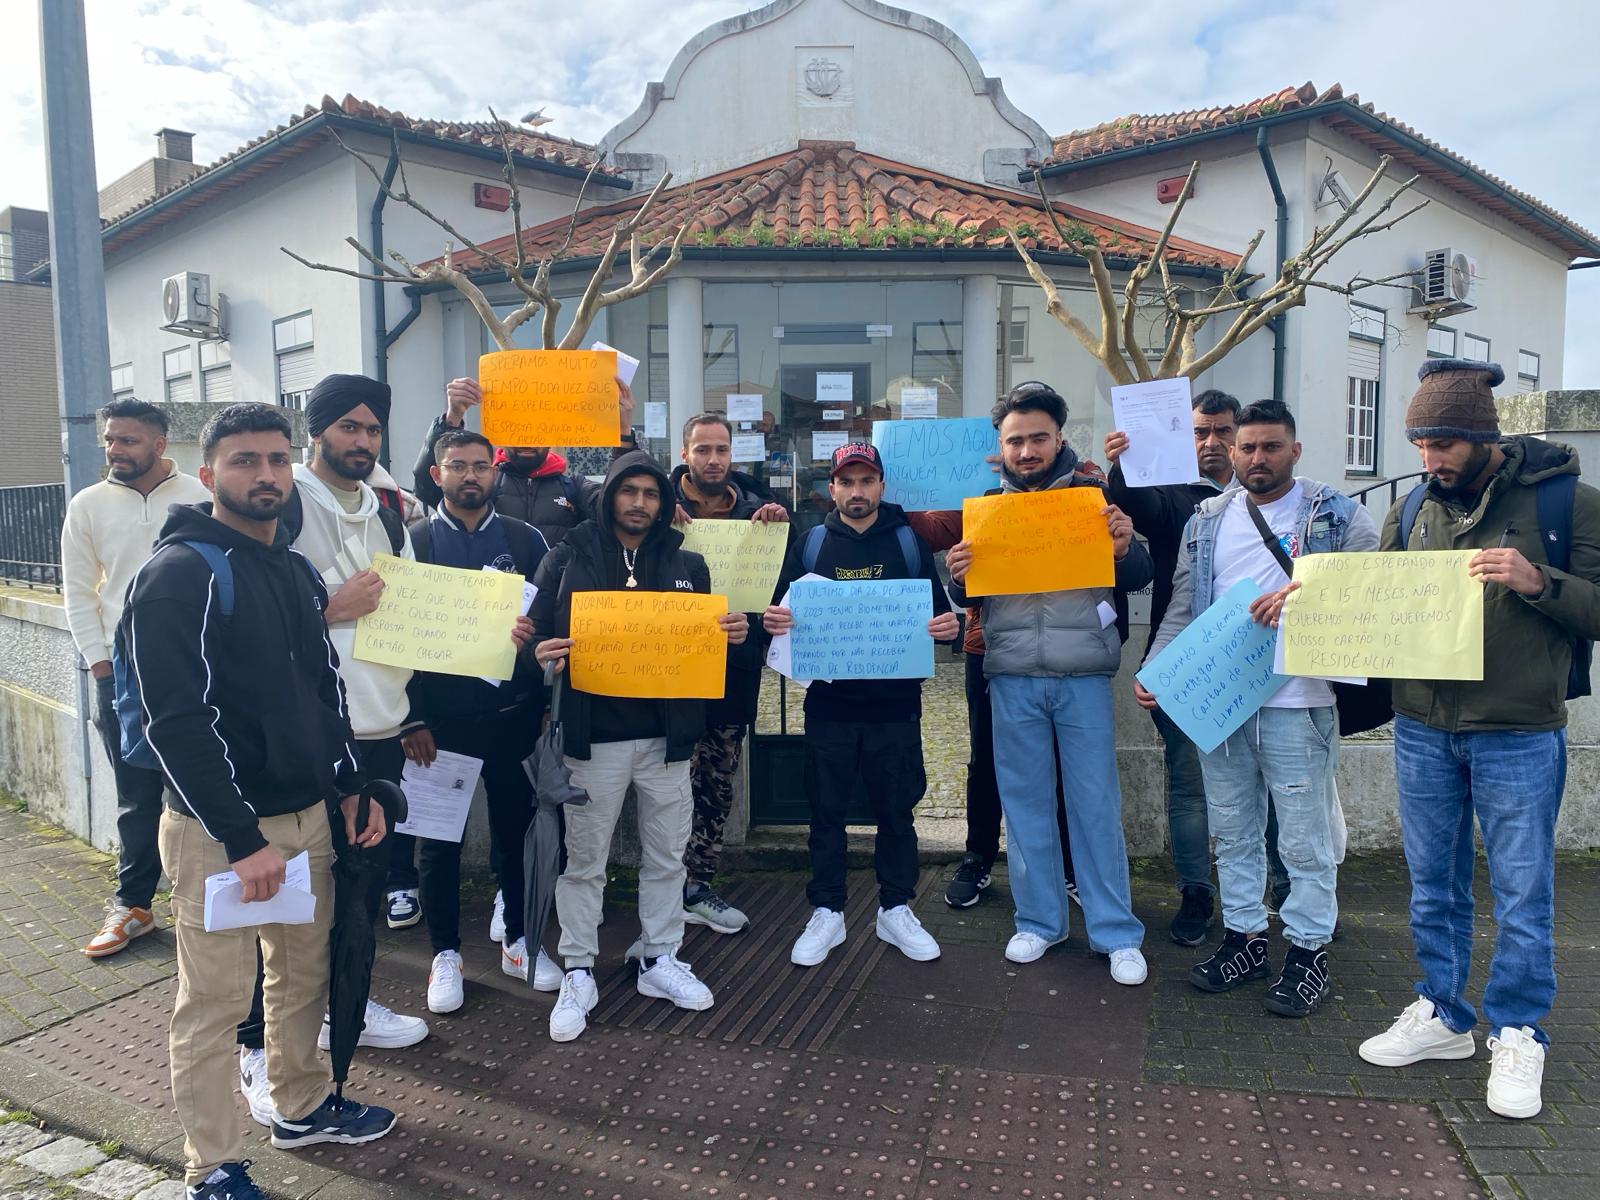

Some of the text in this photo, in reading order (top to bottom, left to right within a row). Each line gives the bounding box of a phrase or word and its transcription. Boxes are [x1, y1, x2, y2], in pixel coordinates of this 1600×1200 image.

[558, 356, 599, 370] MUITO
[482, 377, 612, 395] TEMPO TODA VEZ QUE
[949, 463, 980, 482] NOS
[894, 488, 940, 505] OUVE
[727, 521, 760, 537] MUITO
[755, 544, 777, 556] FALA
[1362, 555, 1436, 571] ESPERANDO
[422, 568, 453, 584] MUITO
[461, 574, 497, 588] TEMPO
[396, 585, 418, 600] VEZ
[426, 593, 447, 606] QUE
[485, 600, 514, 612] FALA
[791, 584, 802, 599] NO
[850, 585, 863, 598] DIA
[866, 585, 877, 597] 26
[882, 584, 894, 597] DE
[896, 583, 930, 597] JANEIRO
[1319, 587, 1329, 602] E
[1338, 585, 1361, 604] 15
[572, 596, 705, 615] NORMAL EM PORTUGAL
[803, 606, 823, 618] 2023
[828, 604, 854, 616] TENHO
[857, 602, 901, 615] BIOMETRIA
[906, 603, 913, 613] E
[409, 605, 449, 624] QUERO
[457, 615, 479, 627] UMA
[1202, 603, 1246, 643] devemos
[1288, 610, 1343, 628] QUEREMOS
[1390, 610, 1454, 627] QUEREMOS
[362, 614, 480, 644] RESPOSTA QUANDO MEU
[572, 616, 593, 636] SEF
[599, 621, 618, 635] DIGA
[622, 622, 639, 634] NOS
[644, 623, 666, 637] QUE
[839, 621, 865, 631] RECEBO
[1289, 632, 1326, 647] NOSSO
[1383, 634, 1402, 648] DE
[416, 646, 454, 661] CHEGAR
[655, 642, 668, 656] 90
[831, 648, 846, 658] POR
[871, 647, 907, 658] RECEBER
[572, 659, 682, 677] E EM 12 IMPOSTOS
[828, 662, 839, 675] DE
[1229, 666, 1242, 682] de
[1220, 937, 1269, 983] AIR
